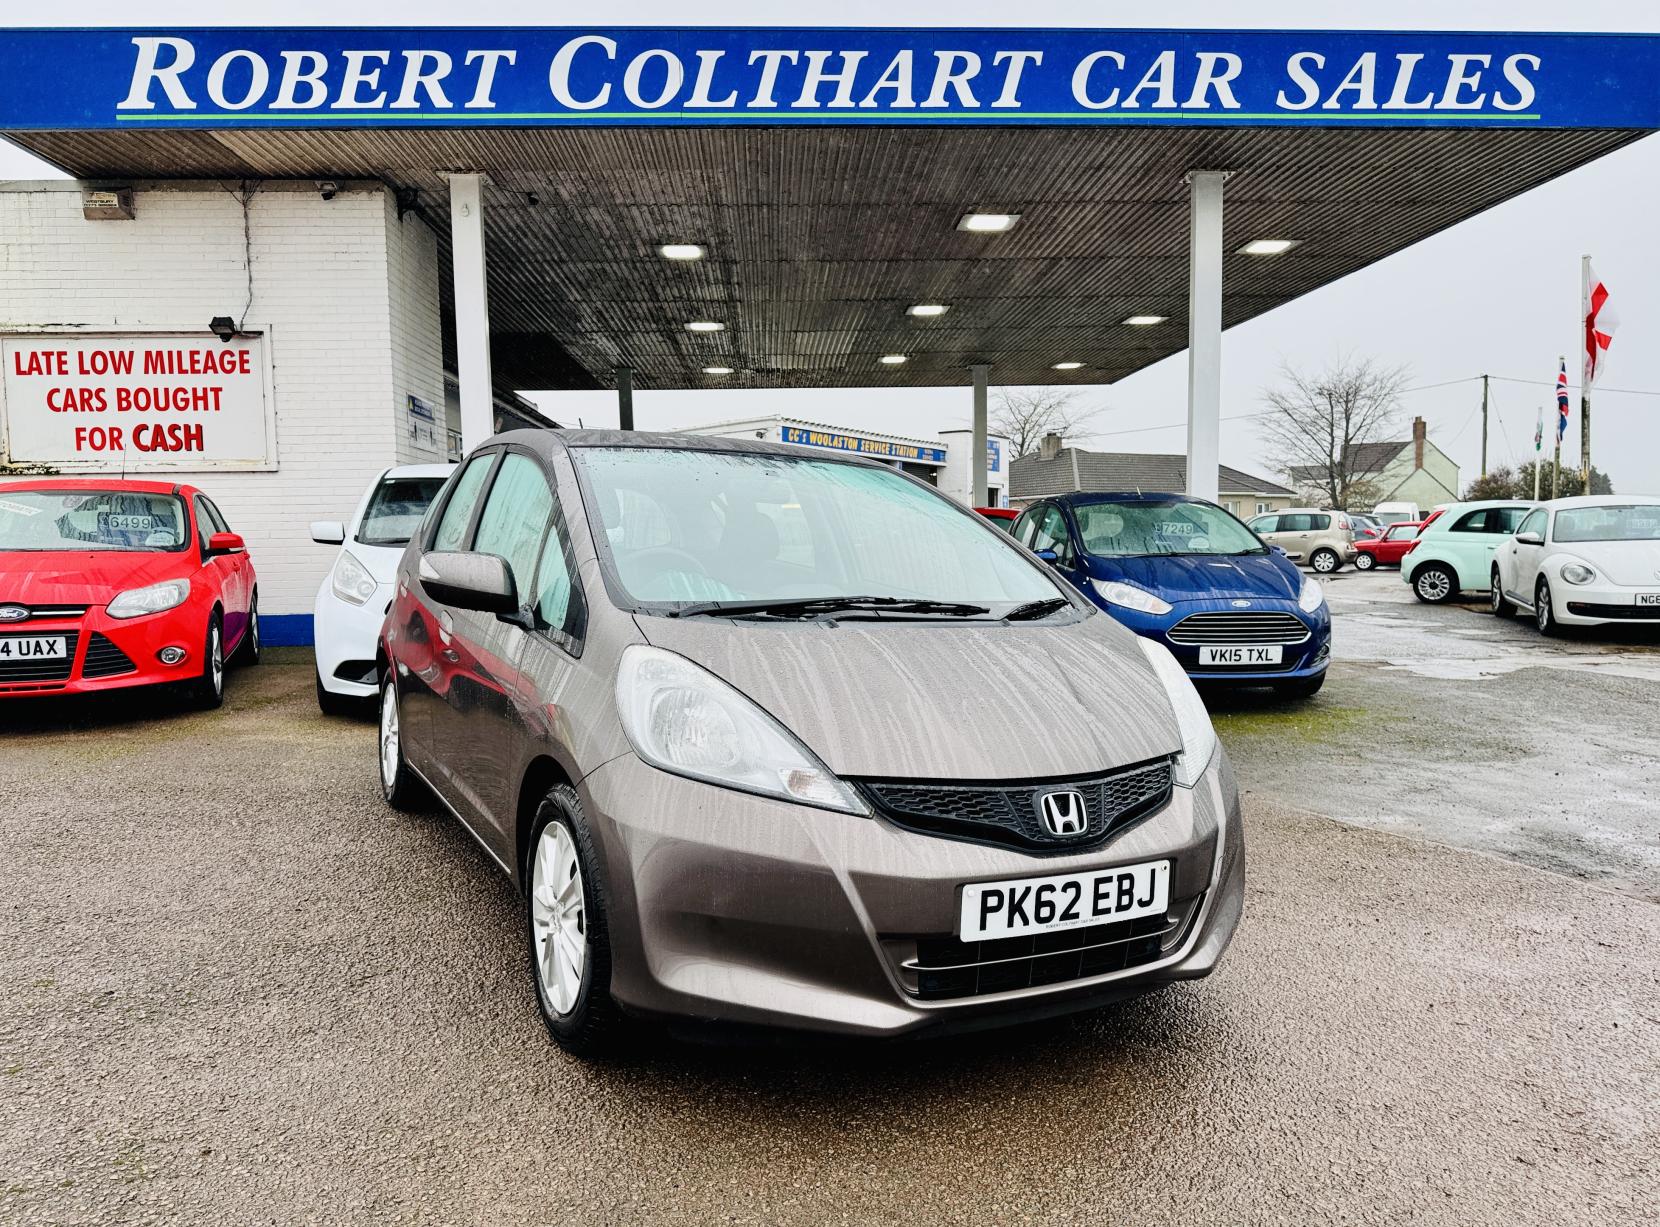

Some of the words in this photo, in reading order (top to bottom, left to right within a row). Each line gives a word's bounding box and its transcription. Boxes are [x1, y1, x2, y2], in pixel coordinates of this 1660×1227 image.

[117, 36, 517, 110] ROBERT
[549, 35, 1044, 110] COLTHART
[1071, 50, 1243, 110] CAR
[1276, 51, 1541, 111] SALES
[14, 350, 69, 376] LATE
[78, 350, 134, 375] LOW
[143, 349, 251, 375] MILEAGE
[46, 387, 108, 413] CARS
[116, 386, 223, 412] BOUGHT
[75, 426, 124, 452] FOR
[132, 423, 204, 452] CASH
[861, 440, 890, 455] SERVICE
[891, 444, 919, 459] STATION
[0, 641, 12, 657] 4
[18, 639, 58, 657] UAX
[1210, 648, 1242, 662] VK15
[1246, 648, 1273, 662] TXL
[979, 880, 1082, 932] PK62
[1092, 868, 1156, 917] EBJ
